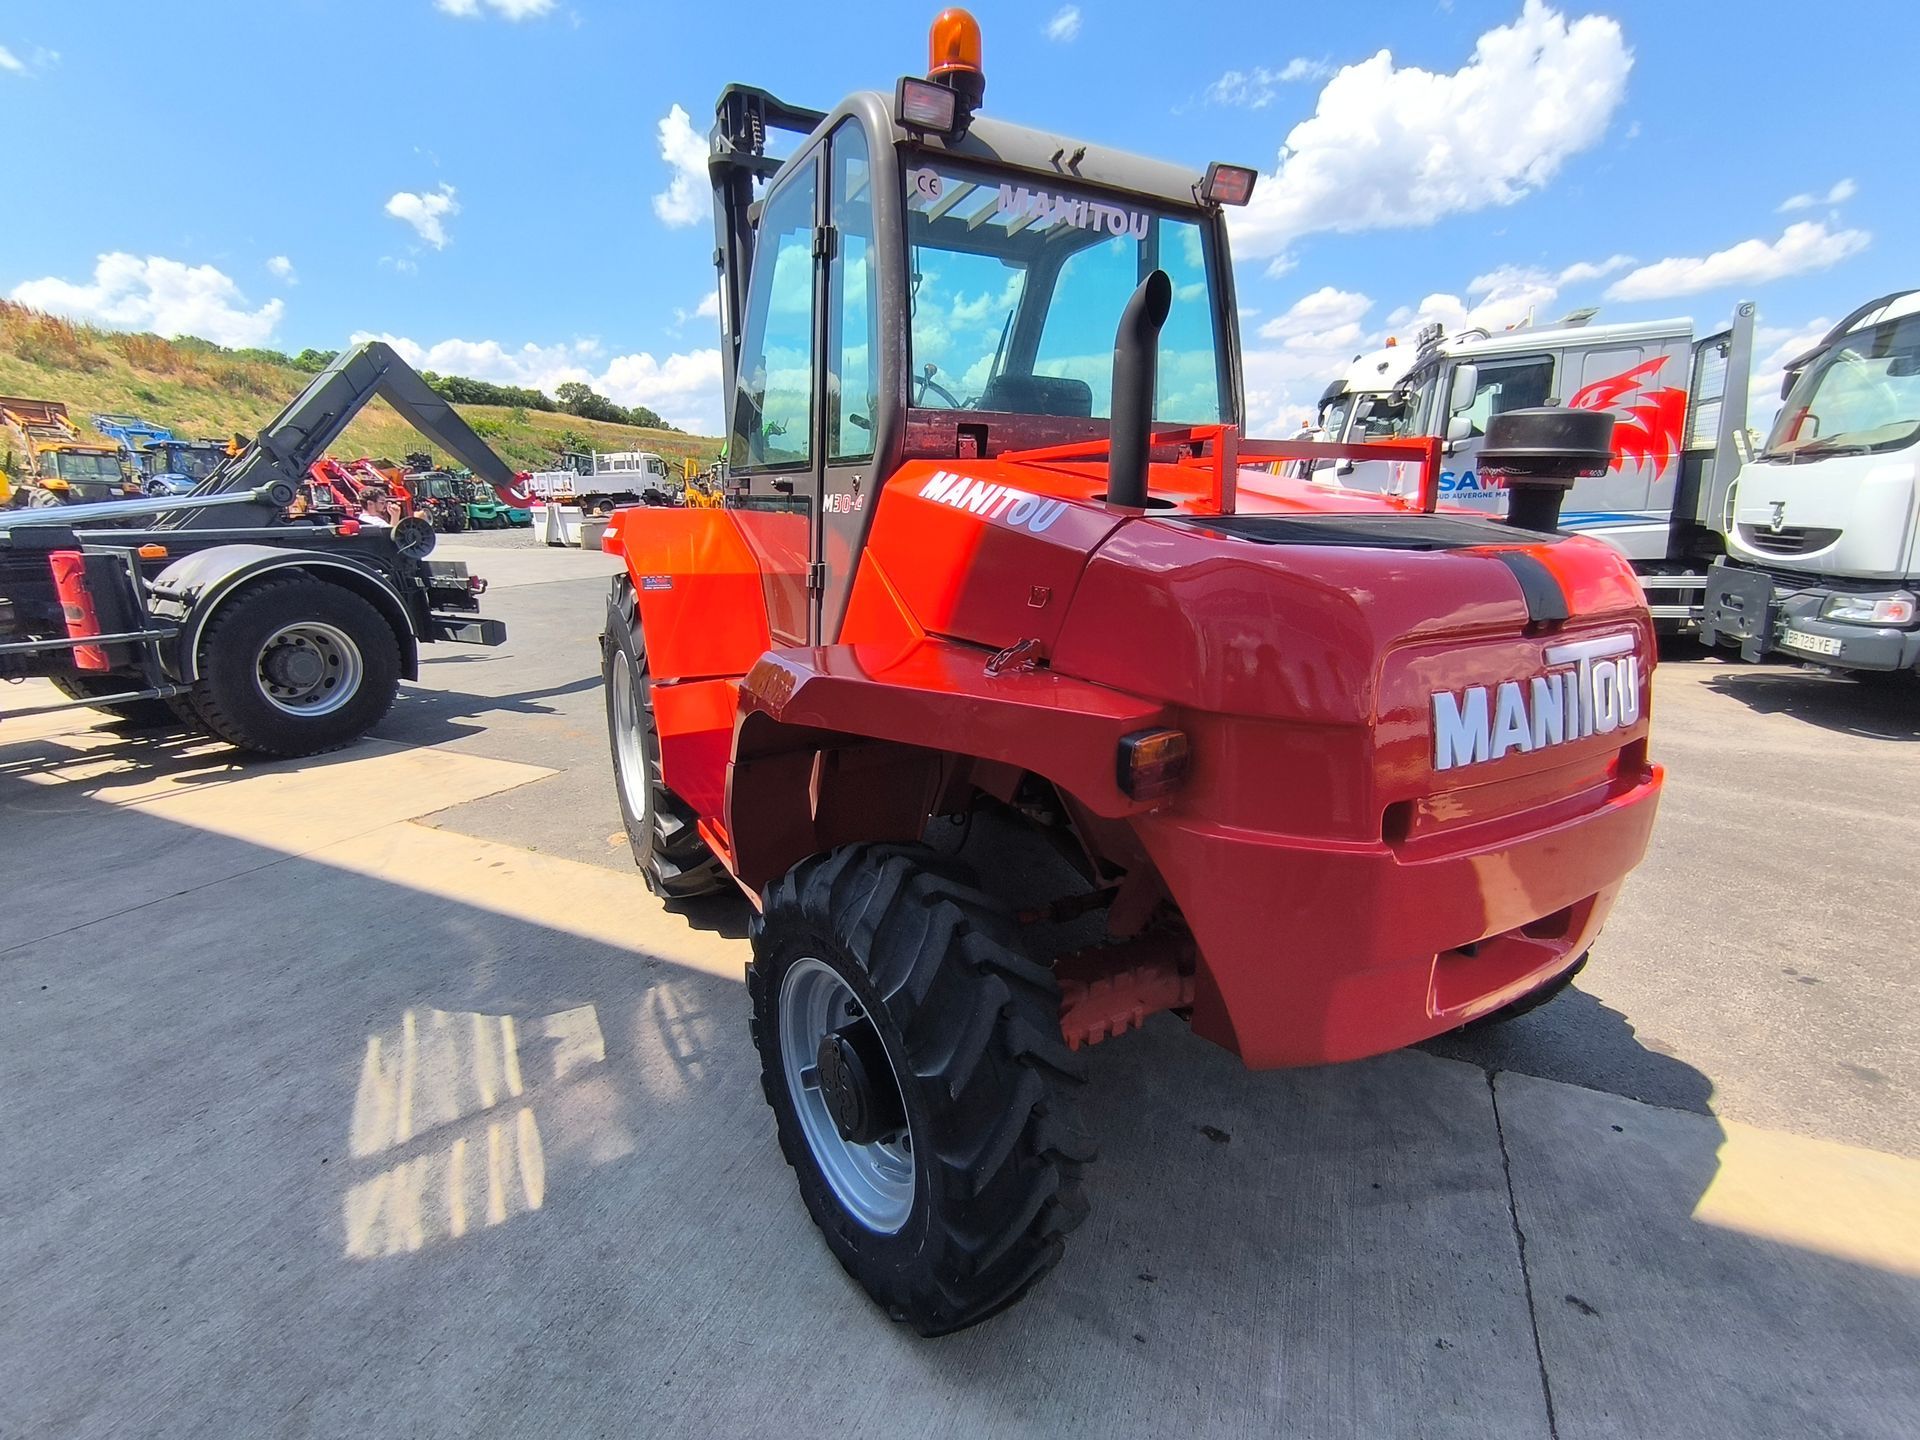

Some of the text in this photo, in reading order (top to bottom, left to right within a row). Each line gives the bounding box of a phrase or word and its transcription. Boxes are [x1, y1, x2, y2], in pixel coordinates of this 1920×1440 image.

[917, 175, 938, 196] CE
[998, 183, 1149, 240] MANITOU
[823, 493, 865, 513] M30-4
[918, 470, 1070, 532] MANITOU
[1452, 491, 1493, 499] AUVERGNE
[1431, 634, 1639, 771] MANITOU
